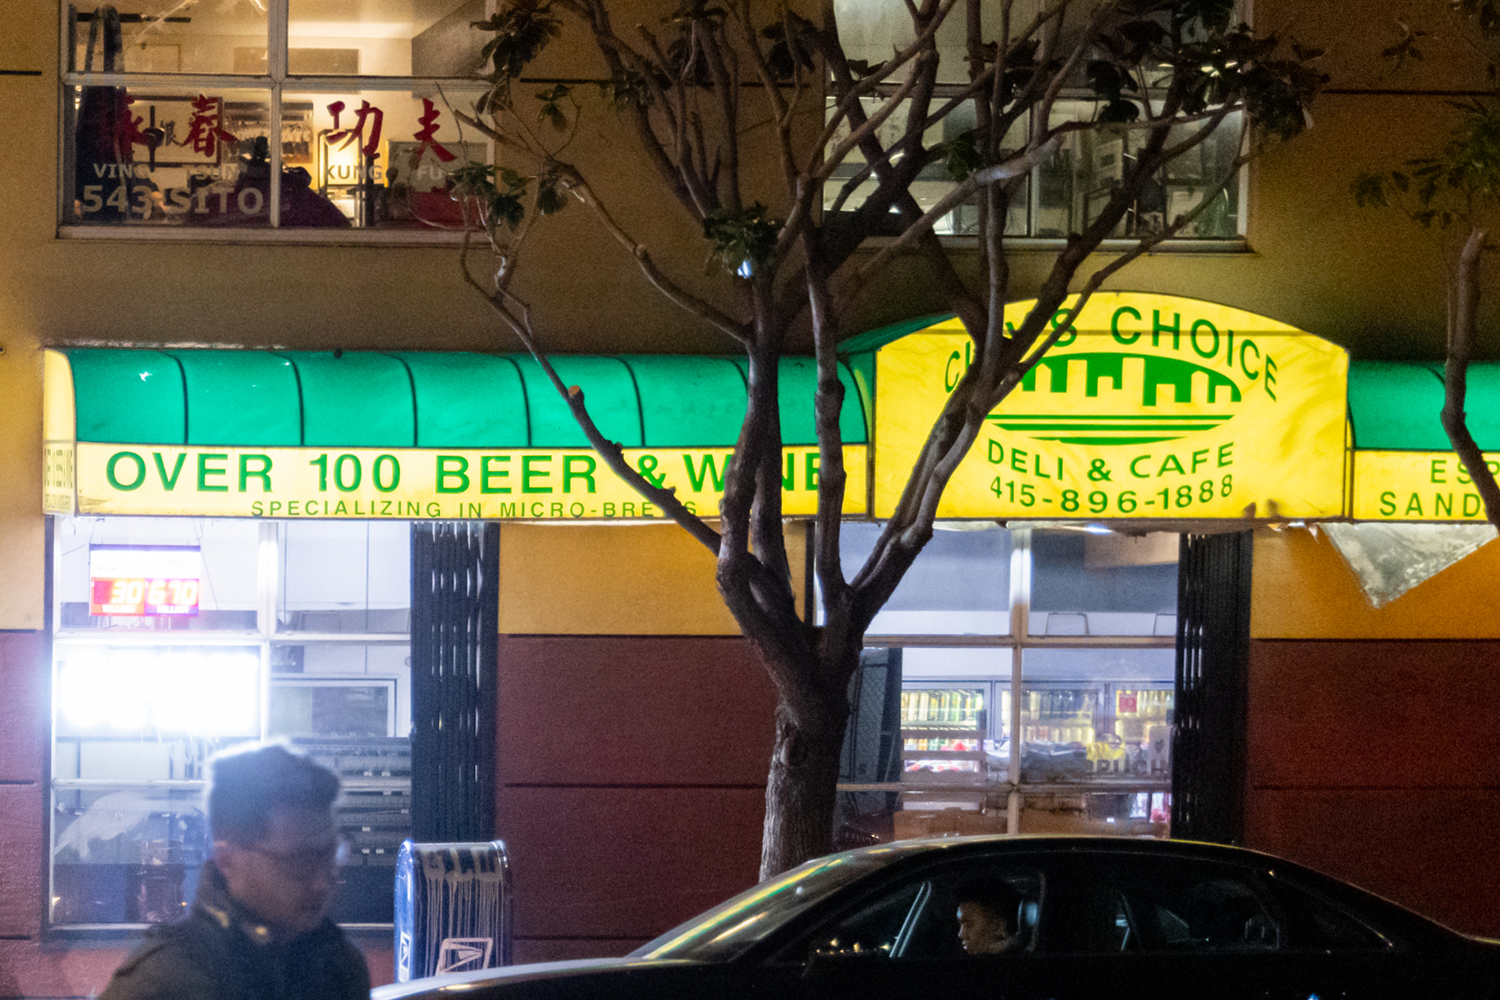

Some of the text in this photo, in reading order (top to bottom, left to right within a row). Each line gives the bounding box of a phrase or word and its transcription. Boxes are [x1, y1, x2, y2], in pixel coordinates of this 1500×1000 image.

[93, 163, 150, 179] VING
[327, 165, 382, 180] KUNG
[418, 165, 444, 180] FU
[84, 186, 264, 214] 543 SITO
[944, 306, 1277, 402] CIS CHOICE
[106, 451, 273, 492] OVER
[309, 453, 401, 493] 100
[435, 454, 597, 494] BEER
[636, 455, 667, 490] &
[988, 439, 1235, 482] DELI & CAFE
[251, 501, 697, 519] SPECIALIZING IN MICRO-BRES
[989, 474, 1233, 514] 415-896-1888
[111, 580, 145, 605] 30
